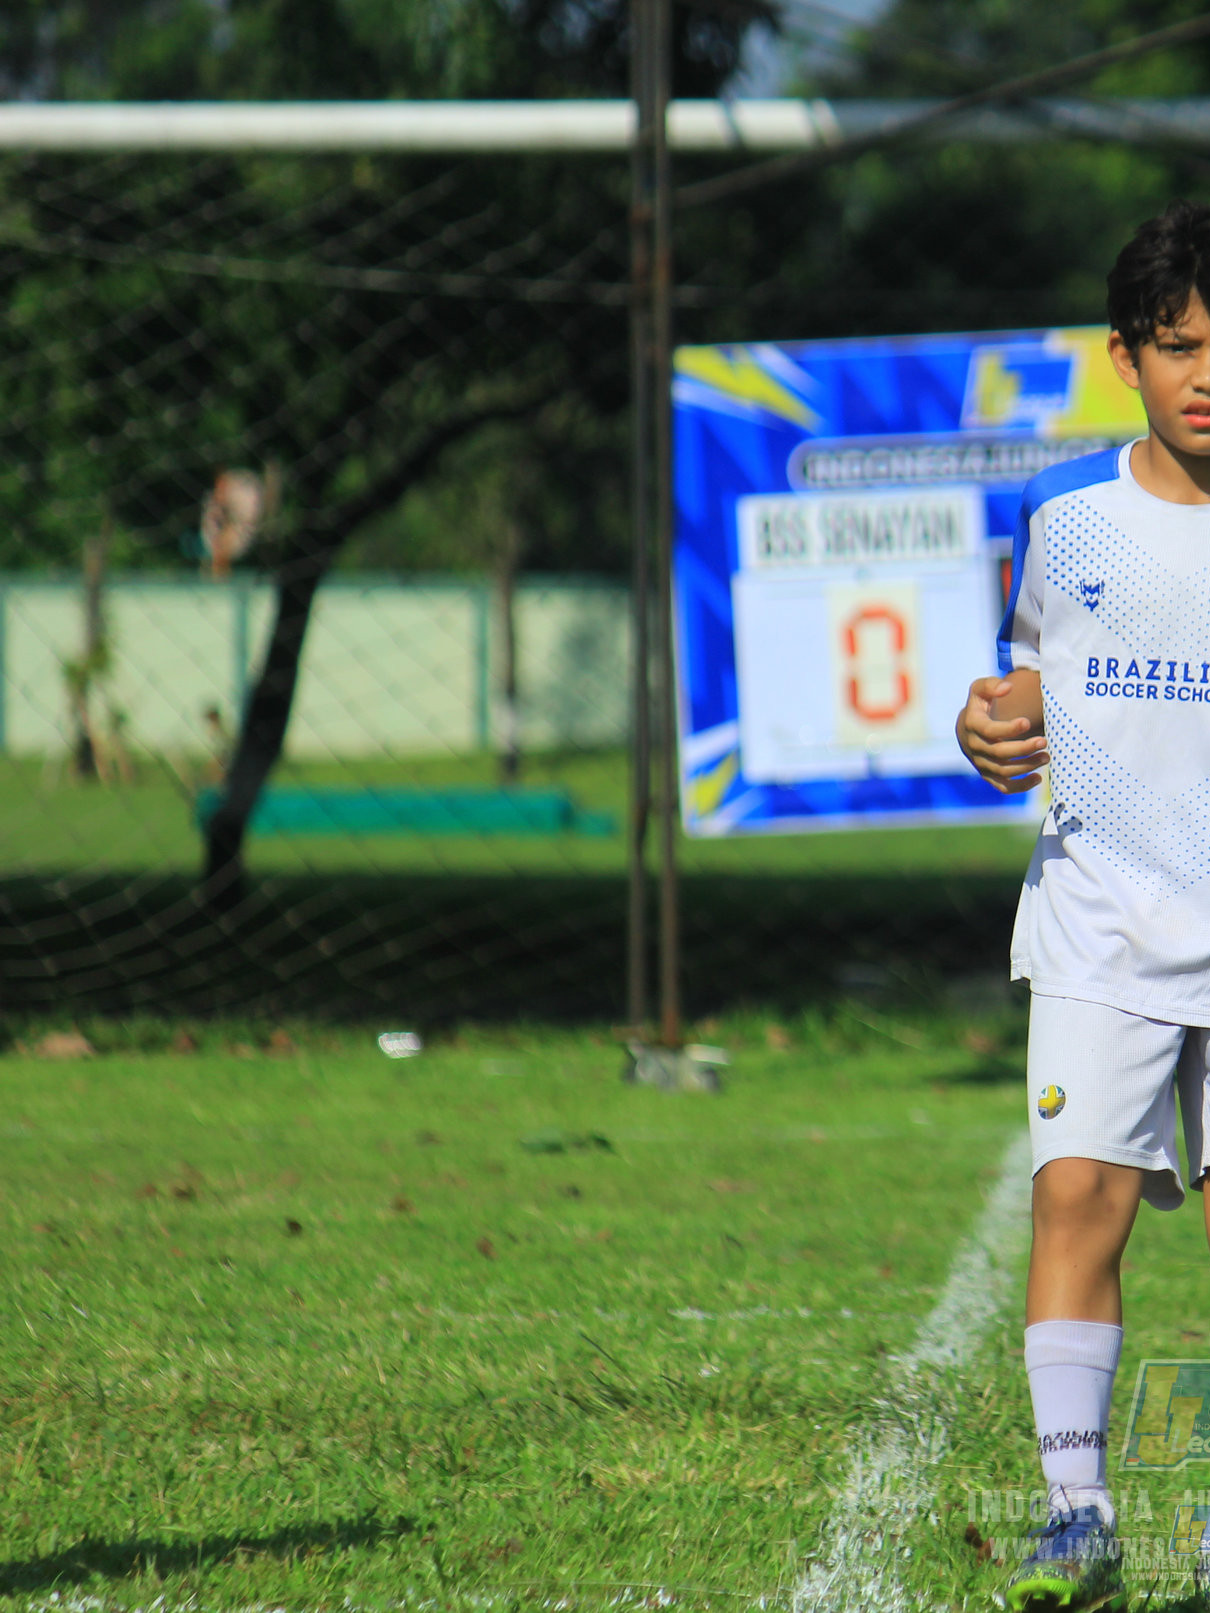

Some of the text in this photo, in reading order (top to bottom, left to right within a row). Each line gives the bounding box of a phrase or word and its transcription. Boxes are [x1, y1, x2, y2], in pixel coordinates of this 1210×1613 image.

[818, 501, 964, 553] SENAYAN
[841, 600, 910, 724] 0
[1085, 682, 1158, 700] SOCCER
